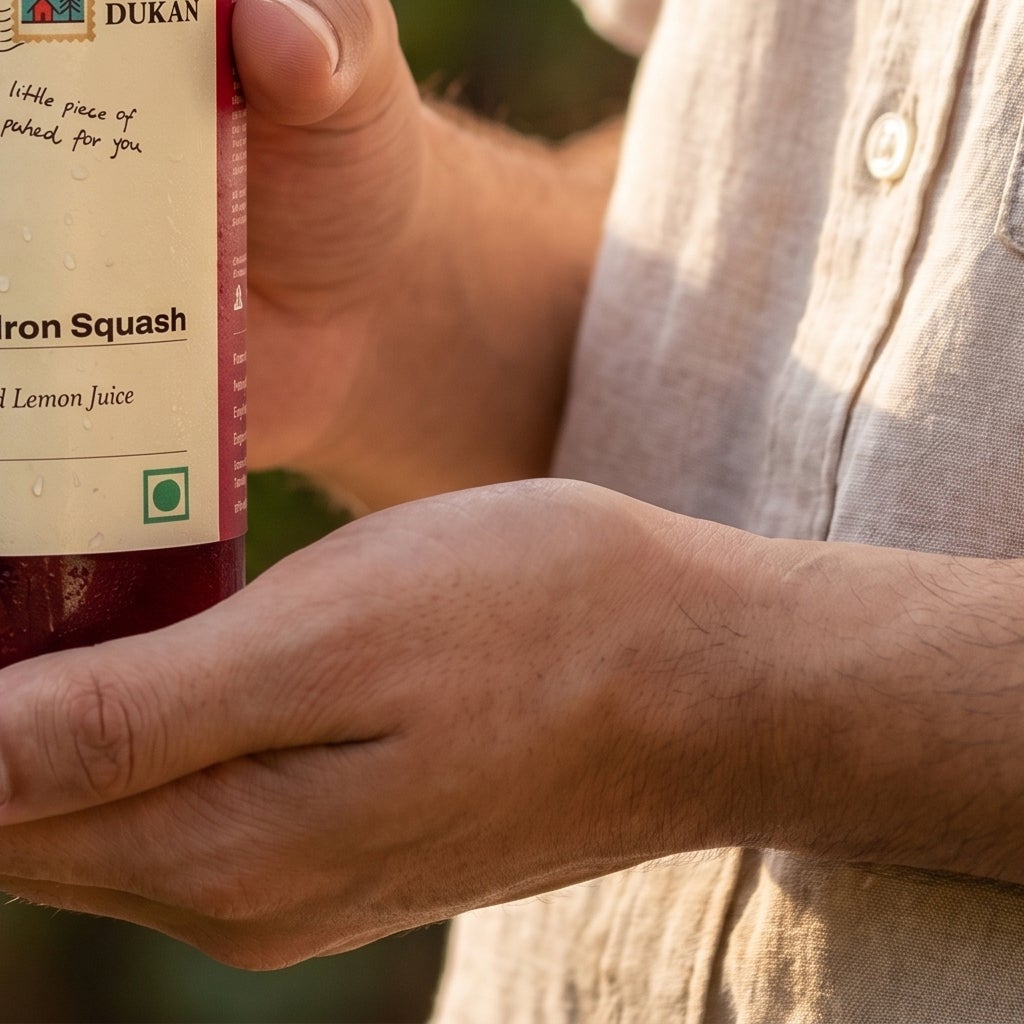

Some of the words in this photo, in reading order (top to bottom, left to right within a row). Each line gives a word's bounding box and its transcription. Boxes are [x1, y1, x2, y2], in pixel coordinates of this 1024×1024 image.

[104, 0, 200, 26] DUKAN
[9, 80, 55, 107] little
[61, 101, 107, 121] piece
[115, 108, 138, 133] of
[72, 128, 102, 152] for
[109, 137, 143, 160] you
[70, 306, 187, 343] Squash
[12, 387, 83, 409] Lemon
[85, 383, 135, 412] Juice
